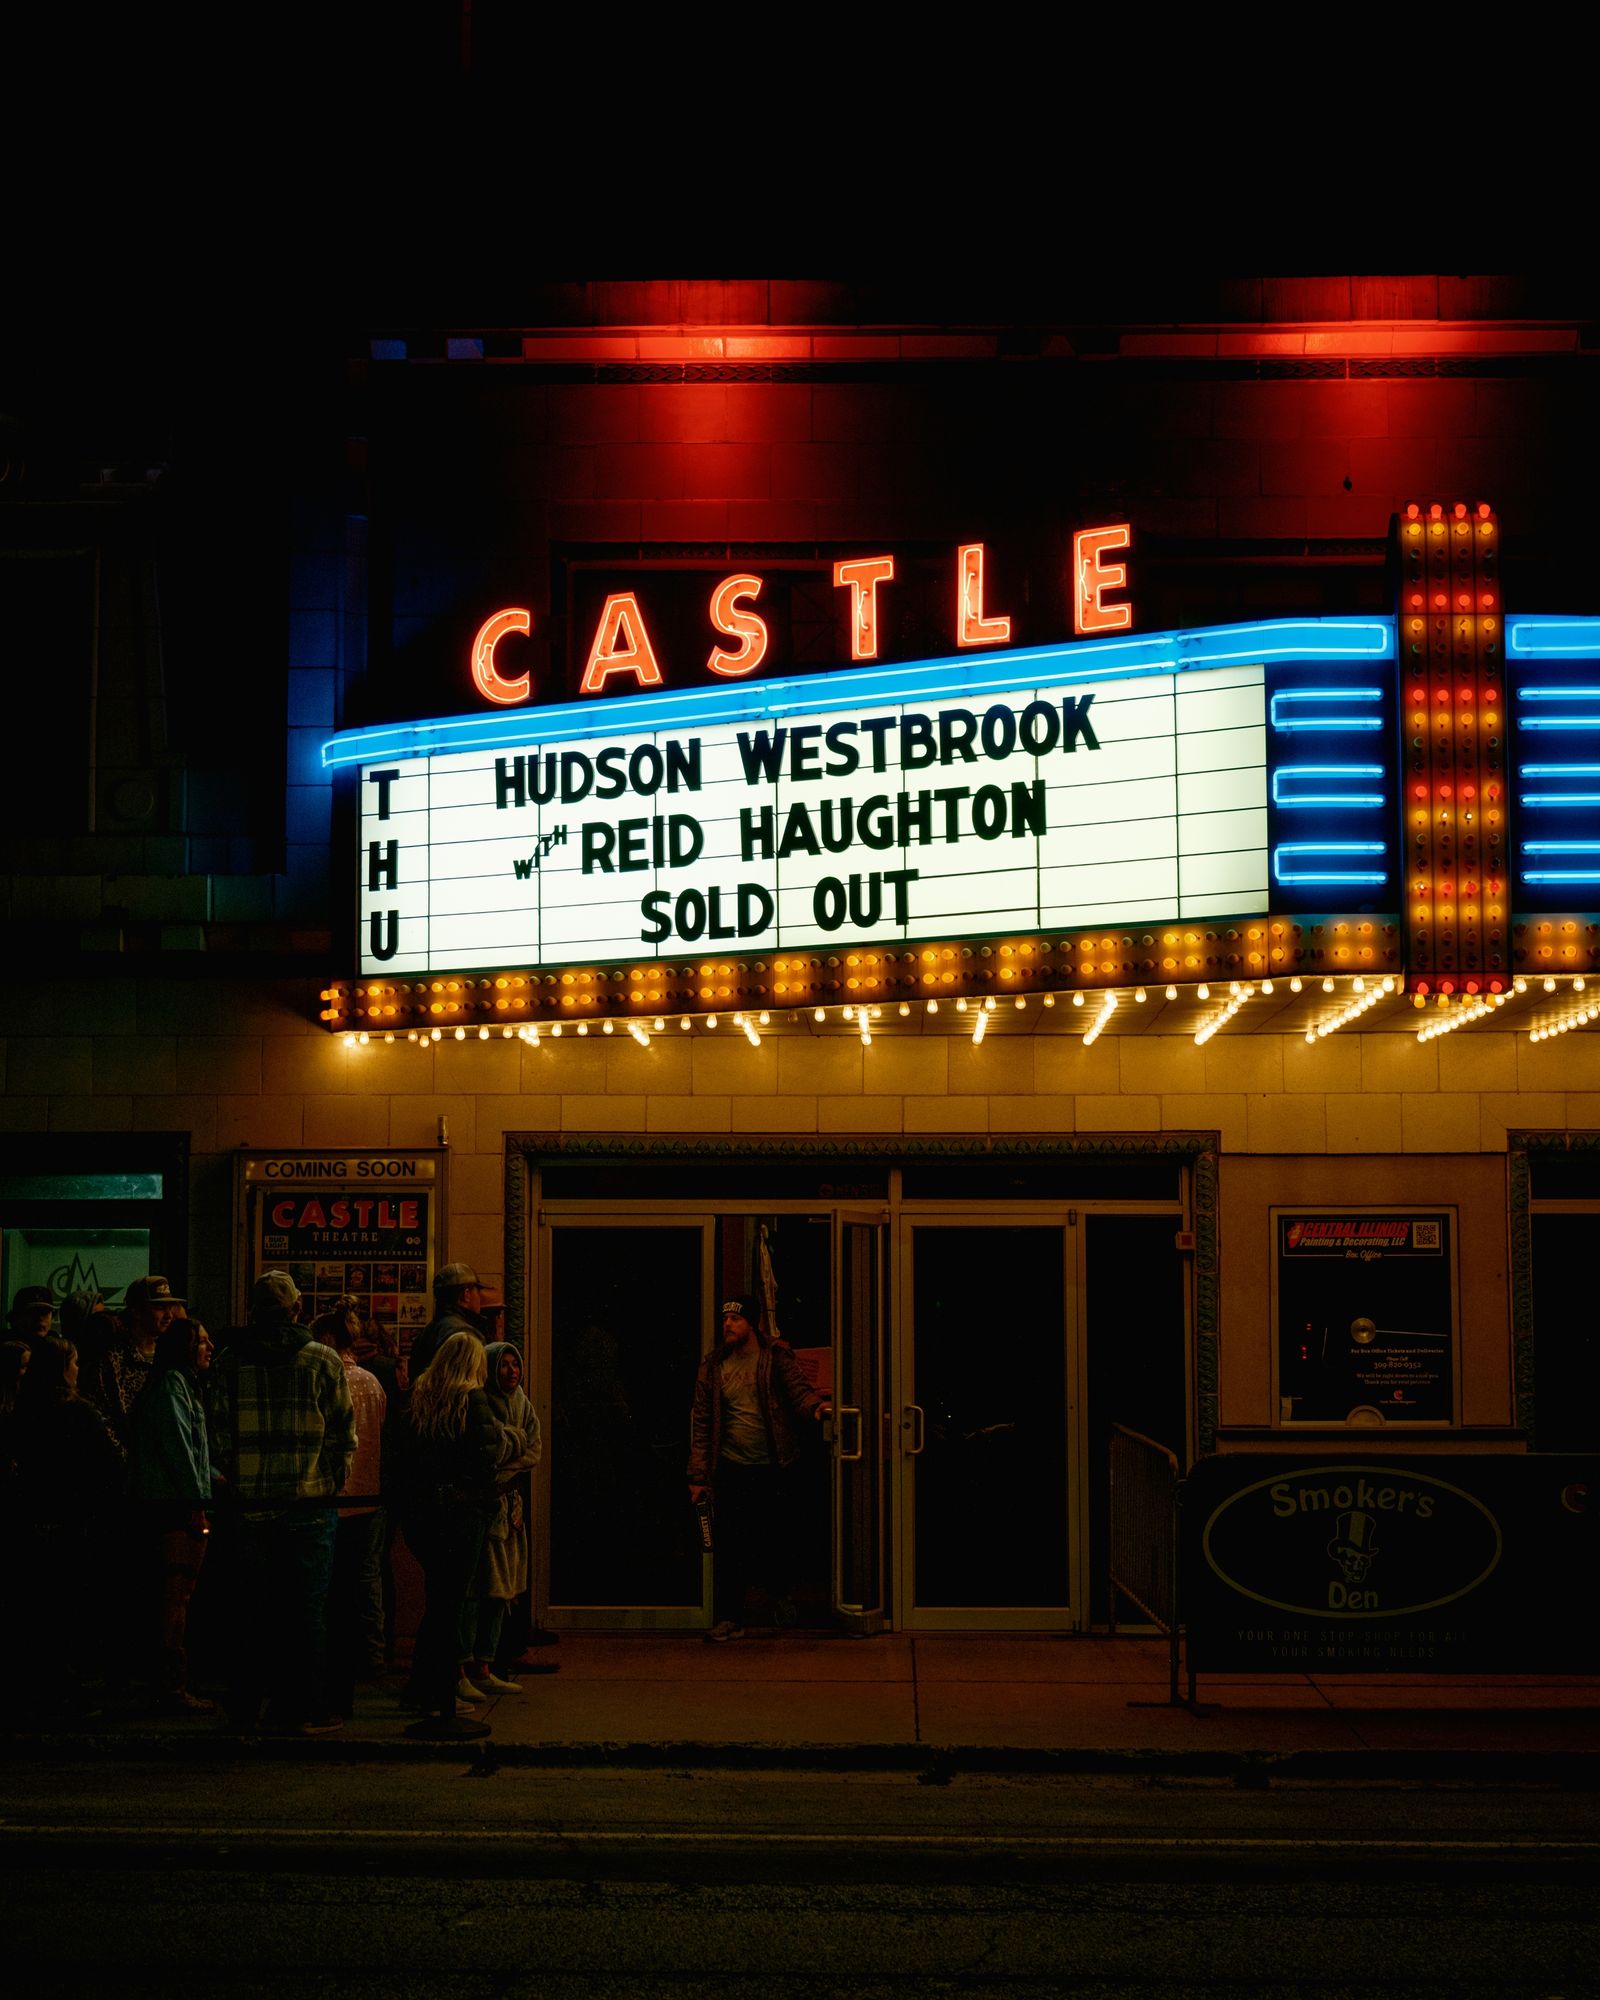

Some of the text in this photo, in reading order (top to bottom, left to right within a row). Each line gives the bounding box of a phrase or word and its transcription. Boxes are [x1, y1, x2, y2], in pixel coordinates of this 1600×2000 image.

[471, 523, 1133, 704] CASTLE
[495, 693, 1102, 810] HUDSON WESTBROOK
[513, 779, 1046, 881] WITH REID HAUGHTON
[640, 869, 919, 944] SOLD OUT
[265, 1160, 416, 1178] COMING SOON
[271, 1200, 420, 1229] CASTLE
[312, 1232, 379, 1242] THEATRE
[1303, 1221, 1410, 1237] CENTRAL ILLINOIS
[1300, 1237, 1405, 1248] Painting & Decorating, LLC
[1359, 1249, 1384, 1261] Office
[1269, 1478, 1437, 1518] Smoker's
[1328, 1579, 1379, 1609] Den
[1237, 1630, 1274, 1641] YOUR
[1282, 1630, 1312, 1641] ONE
[1271, 1647, 1308, 1657] YOUR
[1317, 1647, 1382, 1657] SMOKING
